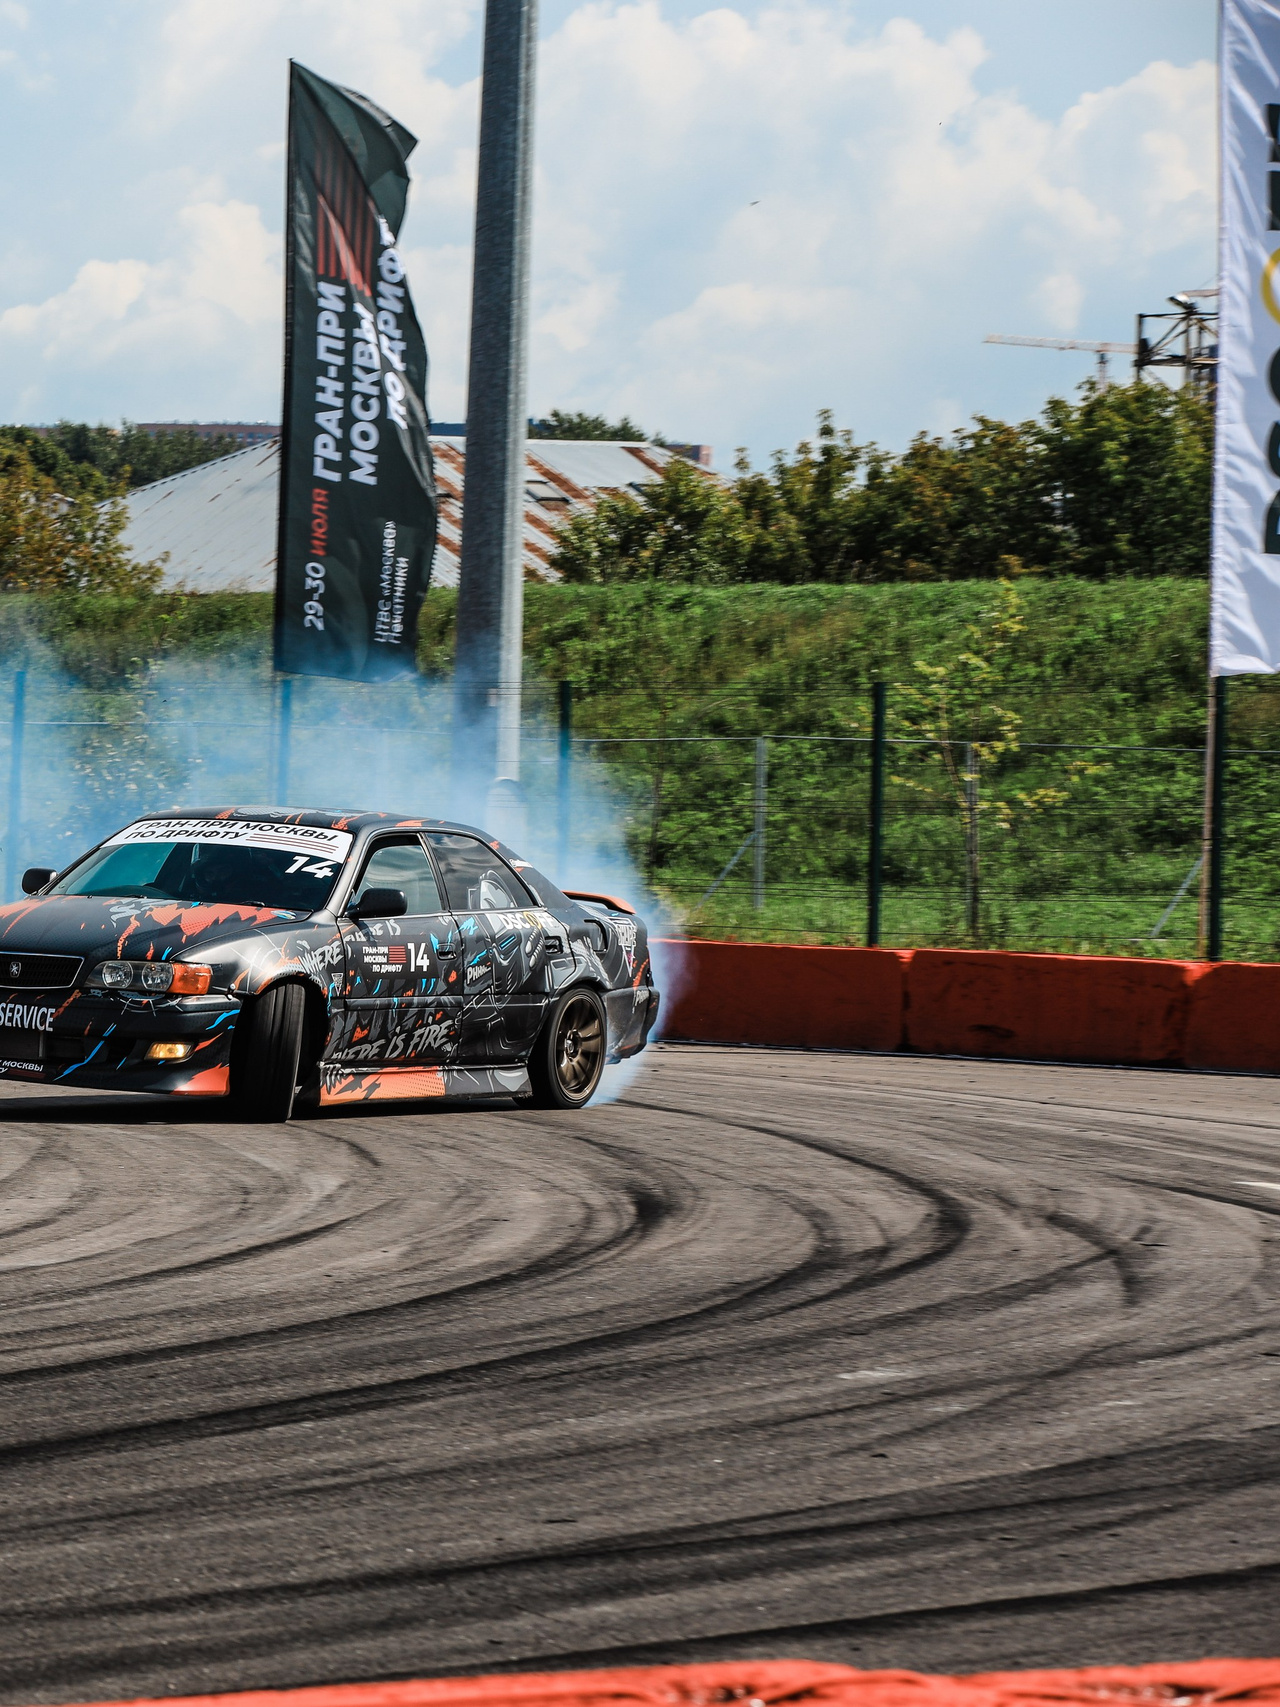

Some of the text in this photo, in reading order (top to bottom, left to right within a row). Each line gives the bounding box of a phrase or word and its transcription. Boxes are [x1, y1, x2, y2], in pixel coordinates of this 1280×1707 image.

[313, 281, 346, 482] ГРАН-ПРИ
[349, 302, 381, 486] МОСКВЫ
[384, 371, 408, 430] ПО
[303, 488, 329, 631] 29-30 ИЮЛЯ
[125, 829, 248, 841] ПО ДРИФТУ
[135, 820, 339, 842] ГРАН-ПРИ МОСКВЫ
[285, 855, 337, 879] 14
[362, 946, 388, 954] ГРАН-ПРИ
[363, 955, 387, 963] МОСКВЫ
[407, 943, 429, 972] 14
[381, 965, 402, 973] ДРИФТУ
[2, 1060, 43, 1071] МОСКВЫ
